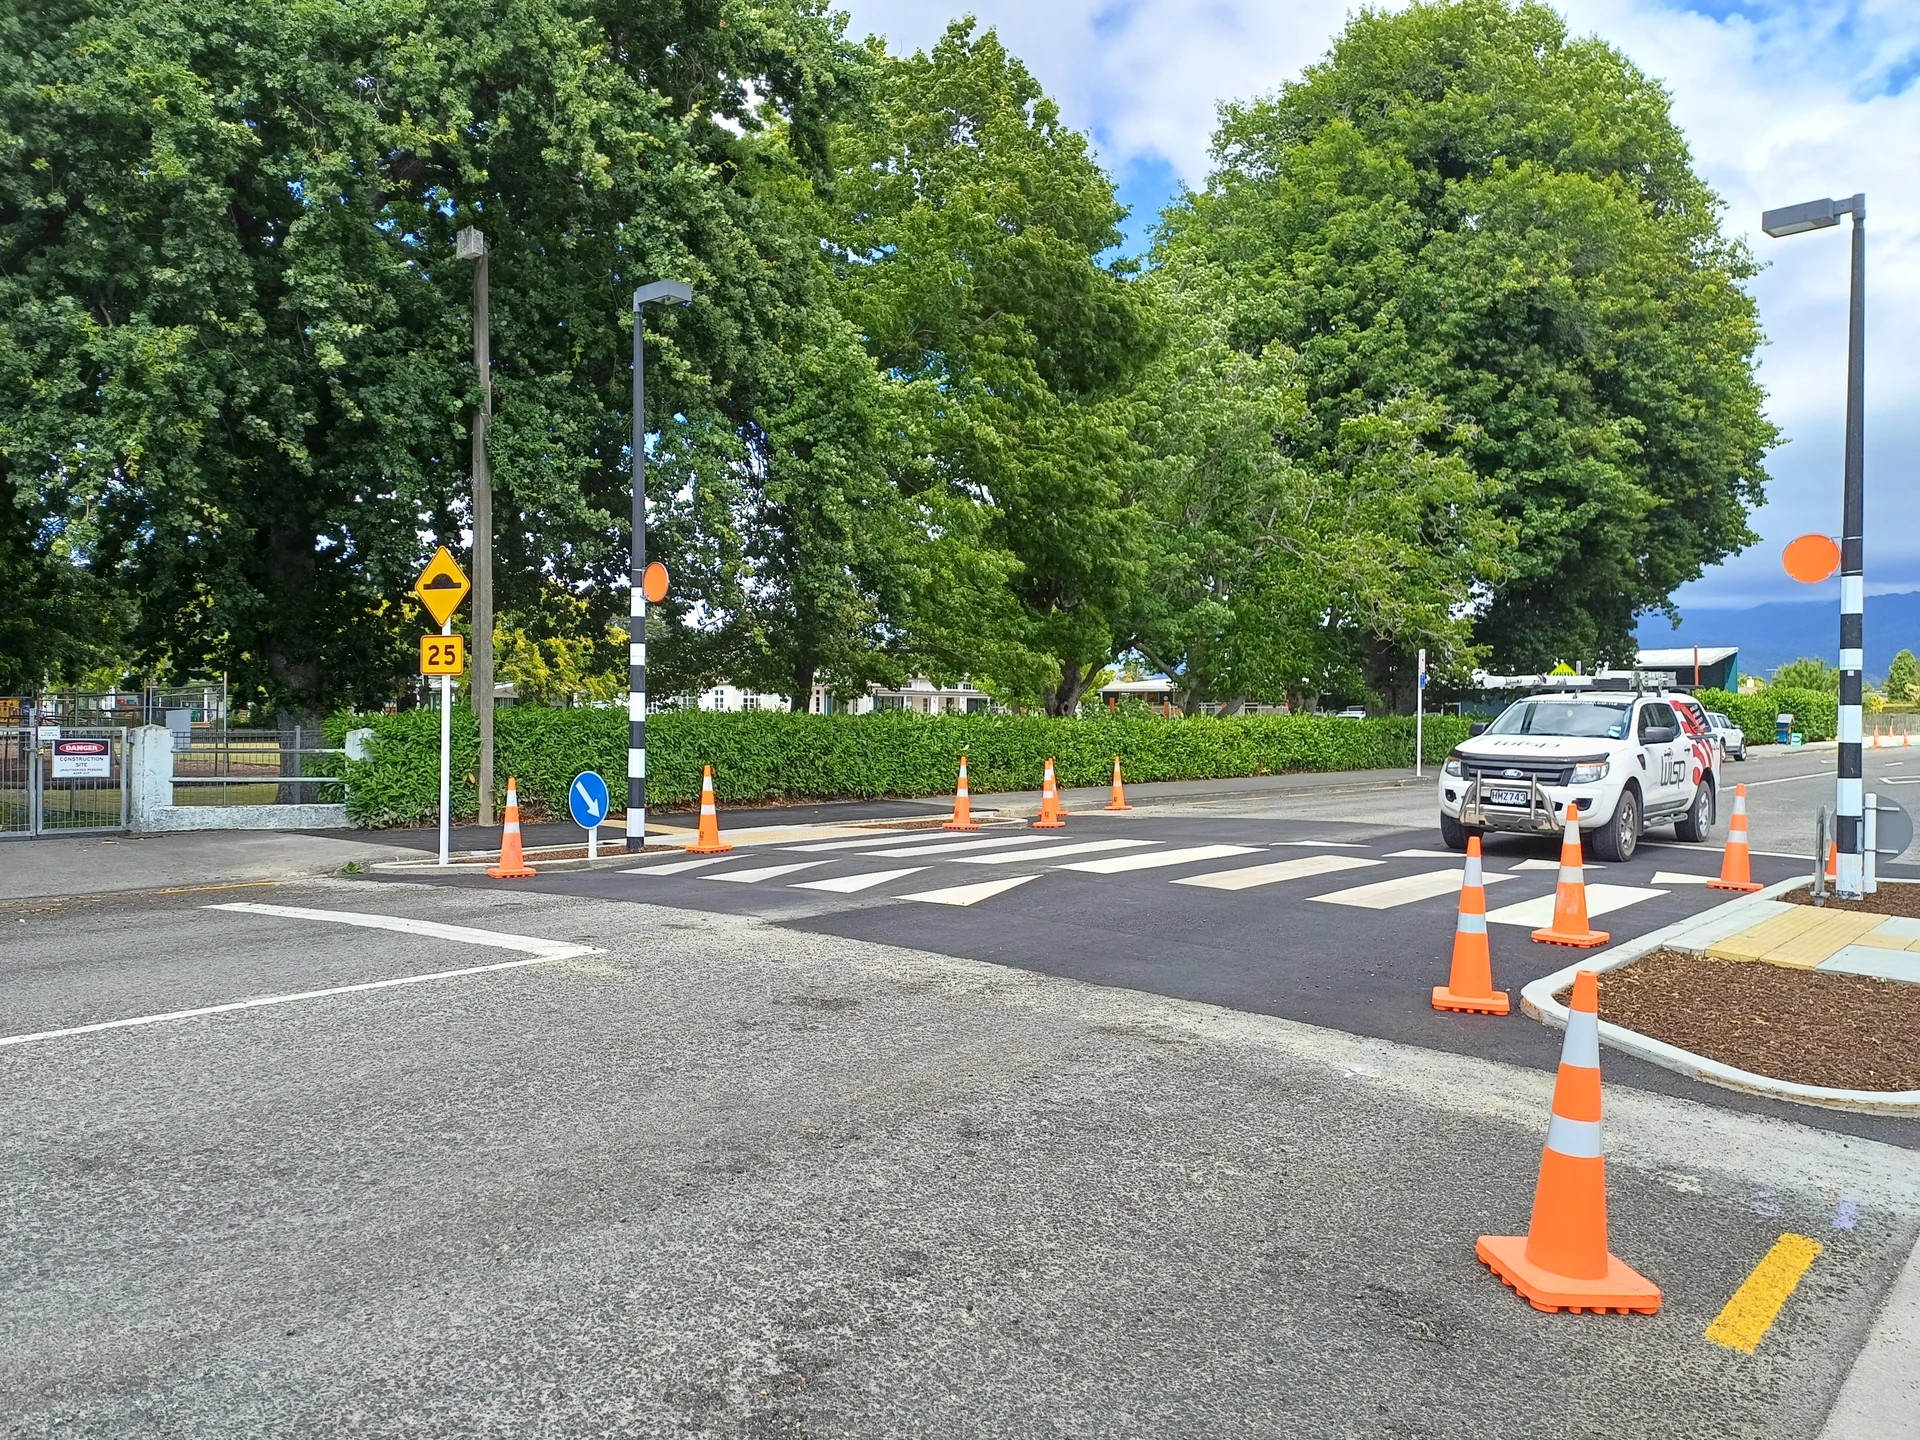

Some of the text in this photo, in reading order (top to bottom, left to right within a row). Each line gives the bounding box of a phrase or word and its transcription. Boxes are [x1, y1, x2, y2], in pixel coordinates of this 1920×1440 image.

[428, 644, 456, 666] 25
[65, 744, 98, 752] DANGER
[1491, 790, 1526, 802] HMZ743
